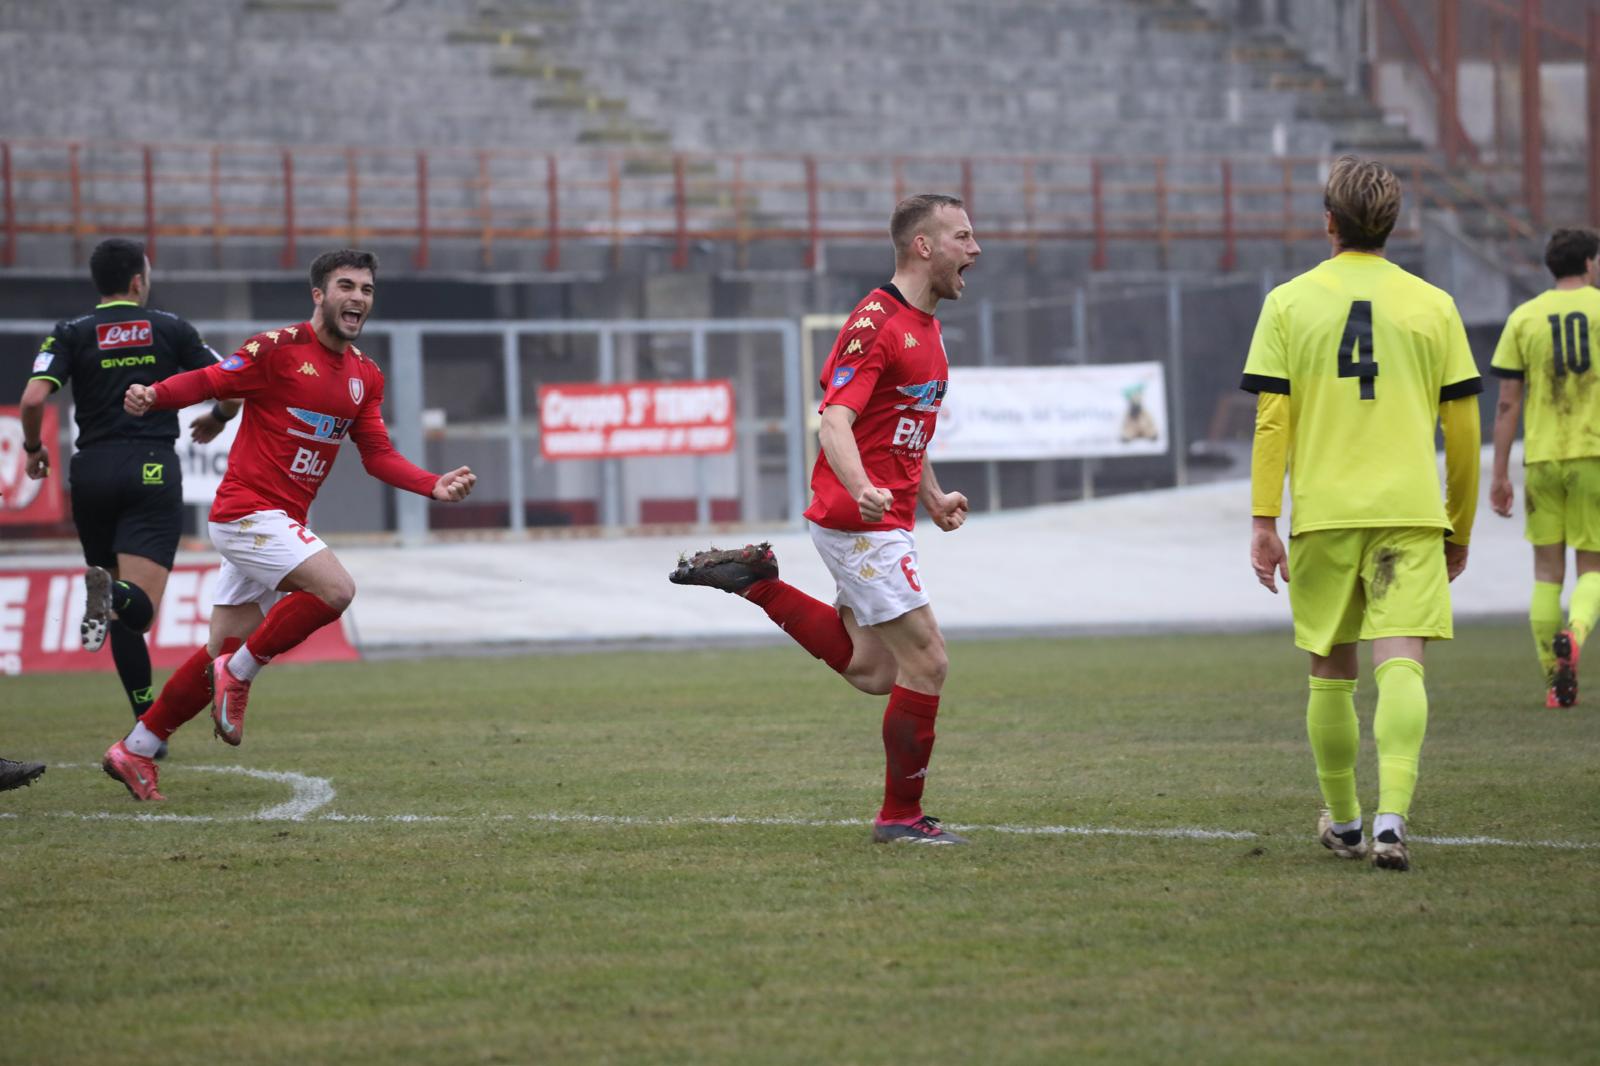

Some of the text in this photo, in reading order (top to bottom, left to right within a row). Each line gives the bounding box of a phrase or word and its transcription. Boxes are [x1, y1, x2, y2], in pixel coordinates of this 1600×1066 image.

[100, 325, 150, 345] Lete
[1337, 300, 1379, 400] 4
[1548, 311, 1591, 378] 10
[101, 355, 156, 368] GIVOVA
[900, 555, 922, 592] 6
